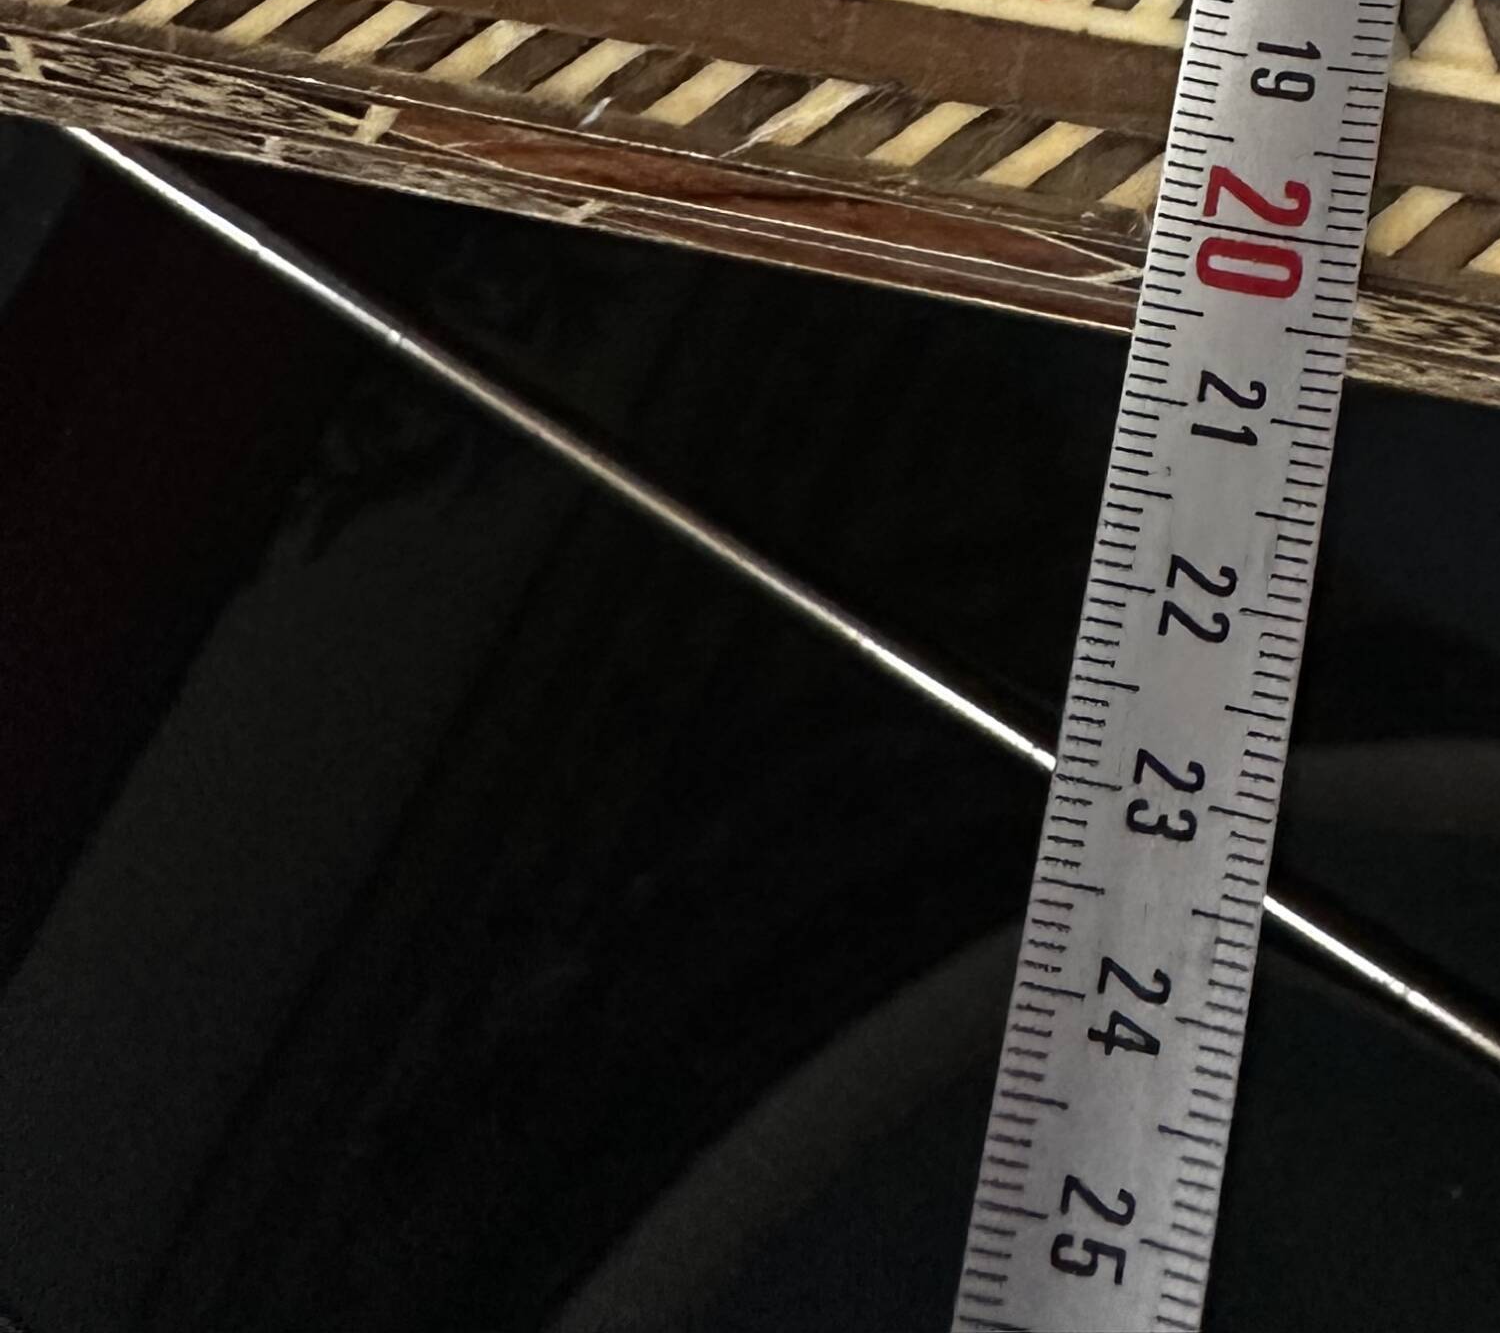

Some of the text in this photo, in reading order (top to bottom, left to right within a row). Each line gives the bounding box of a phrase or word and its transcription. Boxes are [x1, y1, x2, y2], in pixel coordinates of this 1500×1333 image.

[1250, 41, 1321, 102] 19
[1196, 165, 1311, 299] 20
[1191, 370, 1267, 446] 21
[1157, 554, 1237, 644] 22
[1125, 748, 1206, 843] 23
[1087, 956, 1172, 1055] 24
[1051, 1175, 1136, 1285] 25
